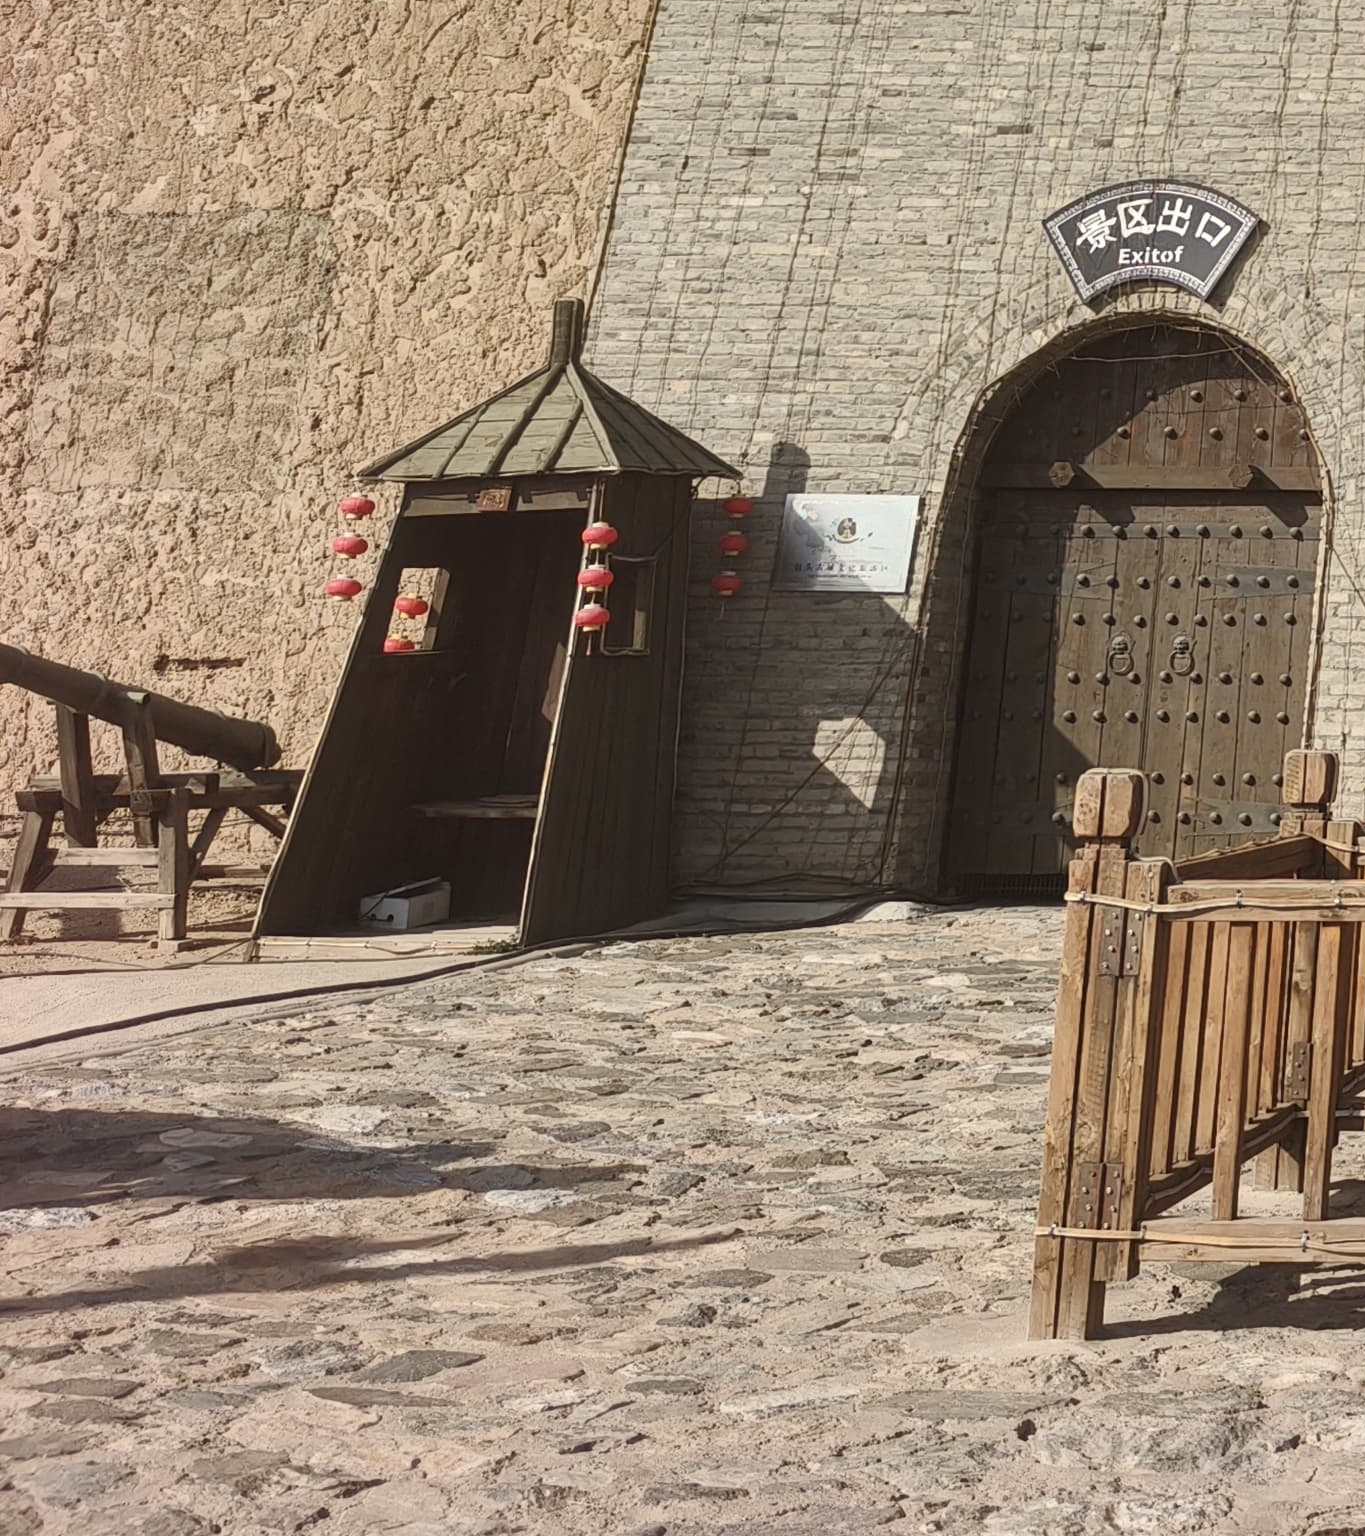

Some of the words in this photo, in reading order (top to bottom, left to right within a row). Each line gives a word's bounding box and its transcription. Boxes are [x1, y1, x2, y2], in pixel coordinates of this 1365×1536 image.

[1076, 197, 1232, 254] 景区出口
[1117, 245, 1185, 265] Exitof
